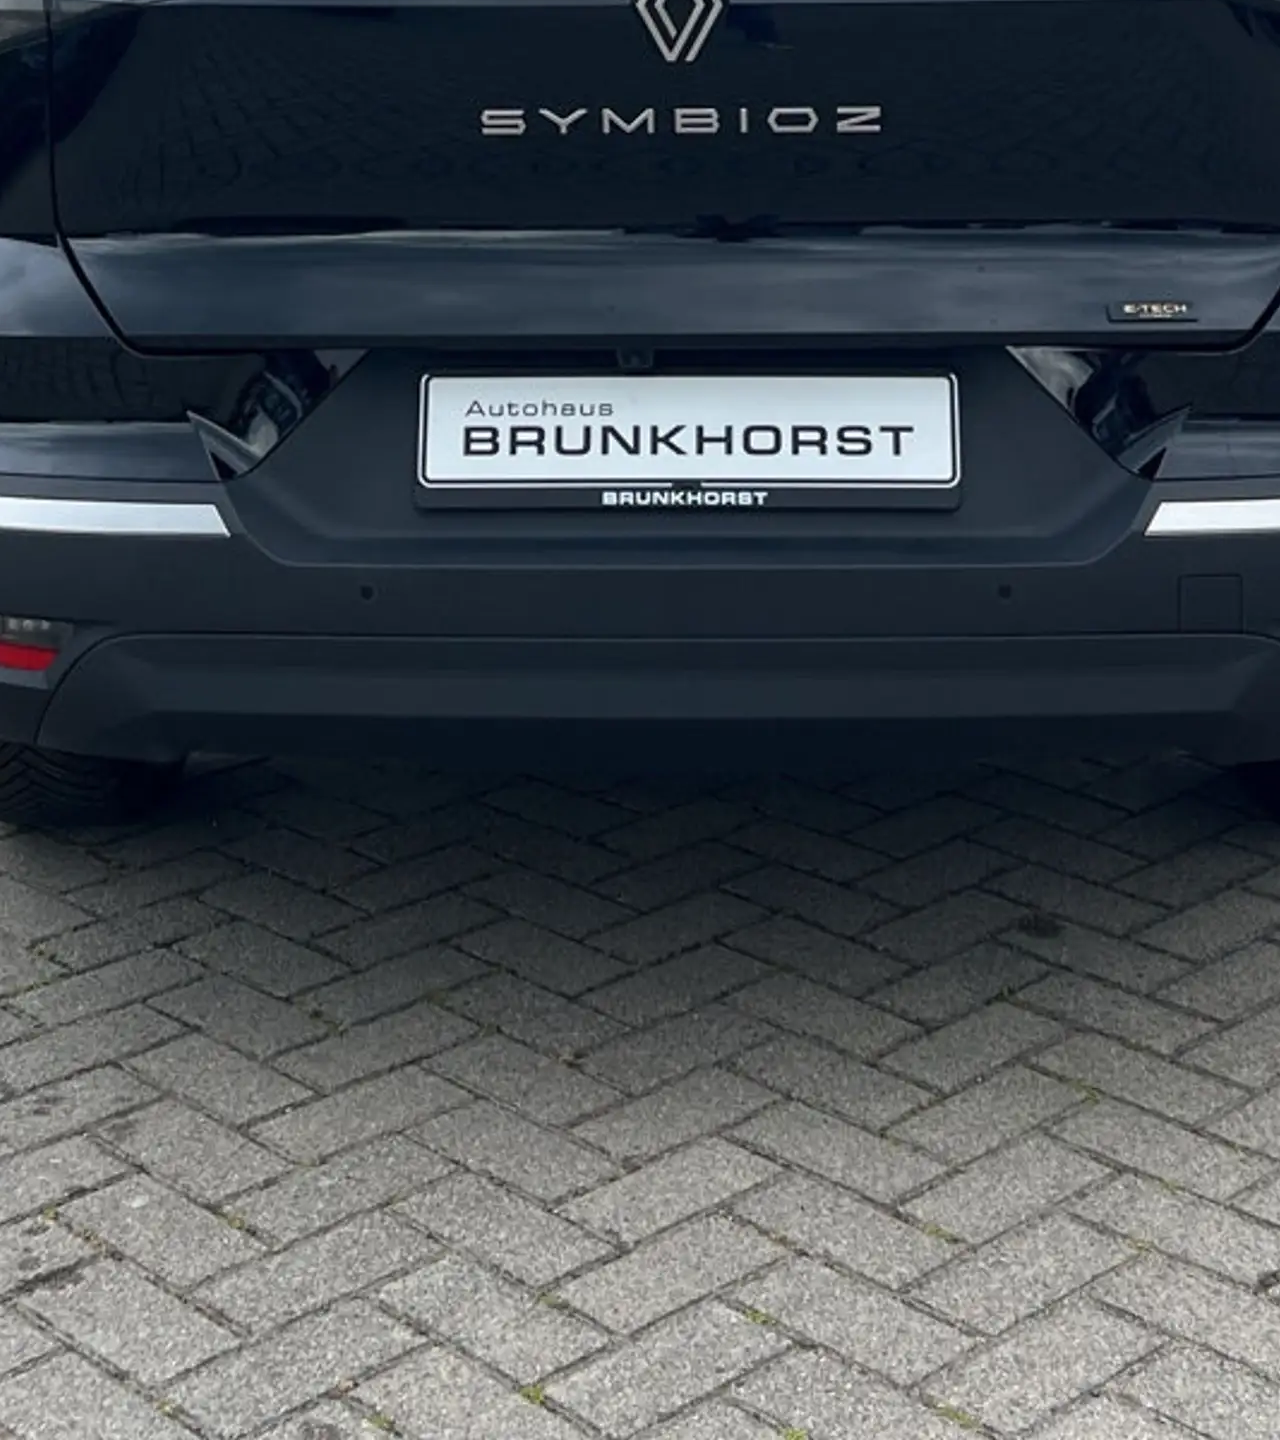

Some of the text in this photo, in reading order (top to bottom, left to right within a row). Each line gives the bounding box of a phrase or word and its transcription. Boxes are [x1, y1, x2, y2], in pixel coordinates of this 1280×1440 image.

[480, 106, 882, 136] SYMBIOZ
[465, 399, 615, 418] Autohaus
[463, 424, 915, 457] BRUNKHORST
[602, 491, 769, 506] BRUNKHORST
